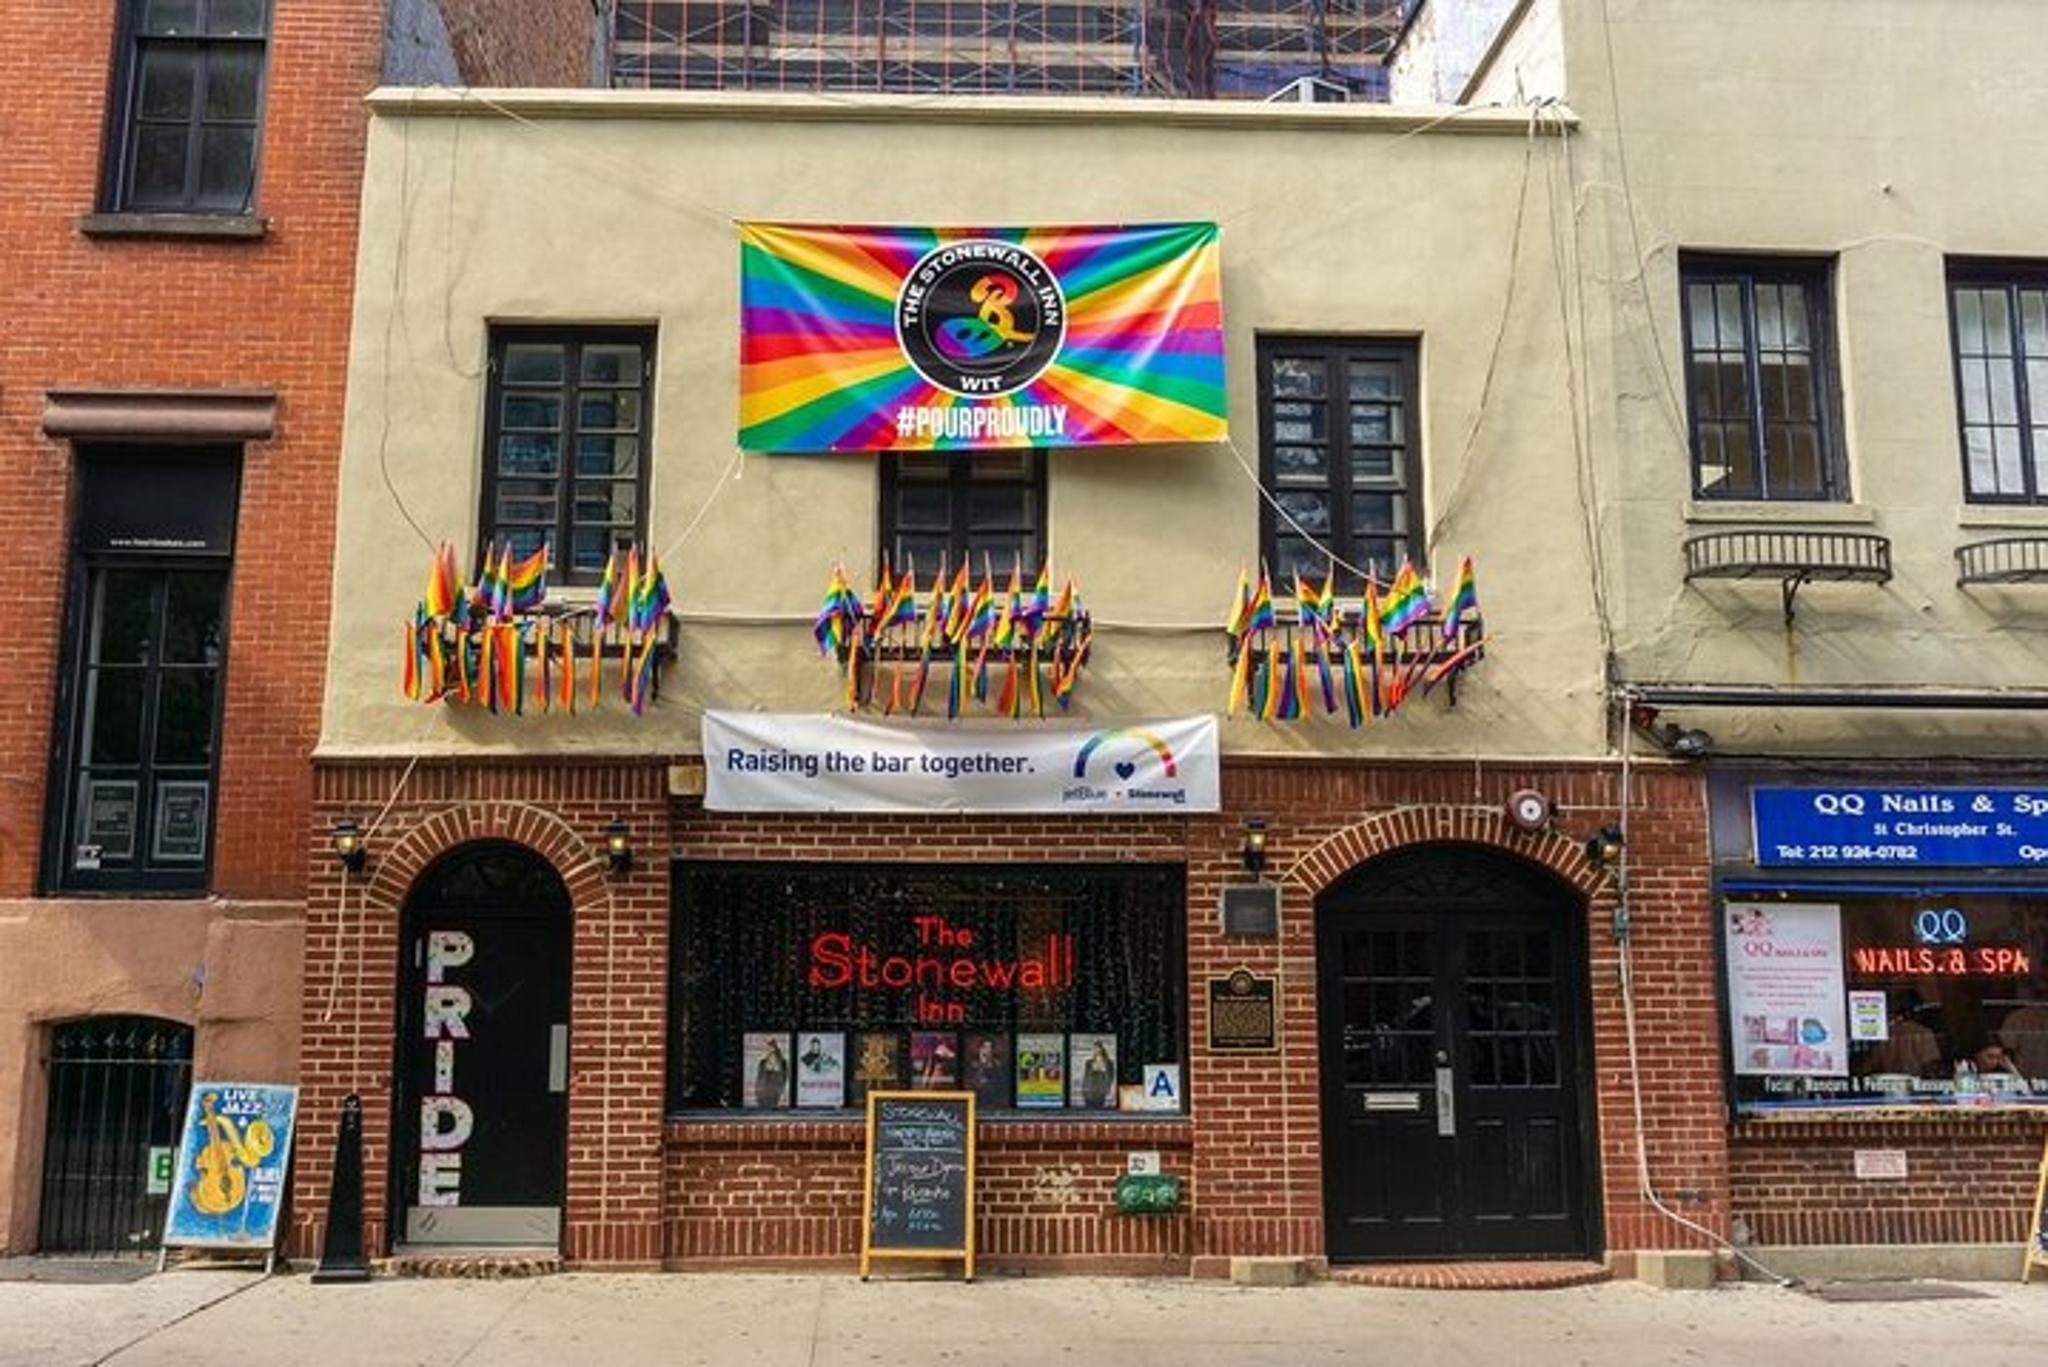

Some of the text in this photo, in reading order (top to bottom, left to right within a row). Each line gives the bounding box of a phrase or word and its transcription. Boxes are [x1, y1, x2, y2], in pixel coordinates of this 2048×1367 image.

[902, 244, 1060, 328] THE STONEWALL INN
[960, 376, 1003, 391] WIT
[896, 404, 1067, 438] #POURPROUDLY
[727, 749, 1035, 779] Raising the bar together.
[1814, 793, 1866, 815] QQ
[1881, 794, 1955, 813] Nails
[1971, 794, 1995, 813] &
[1895, 822, 1988, 838] Christopher
[1996, 822, 2018, 836] St.
[1808, 844, 1838, 859] 212
[2019, 845, 2048, 861] Op
[913, 915, 973, 946] The
[1916, 908, 1967, 943] QQ
[808, 933, 1073, 988] Stonewall
[1981, 948, 2031, 974] SPA
[916, 993, 964, 1023] Inn
[418, 930, 475, 1207] PRIDE
[1150, 1069, 1174, 1097] A
[222, 1102, 262, 1114] JAZZ
[224, 1090, 256, 1100] LIVE
